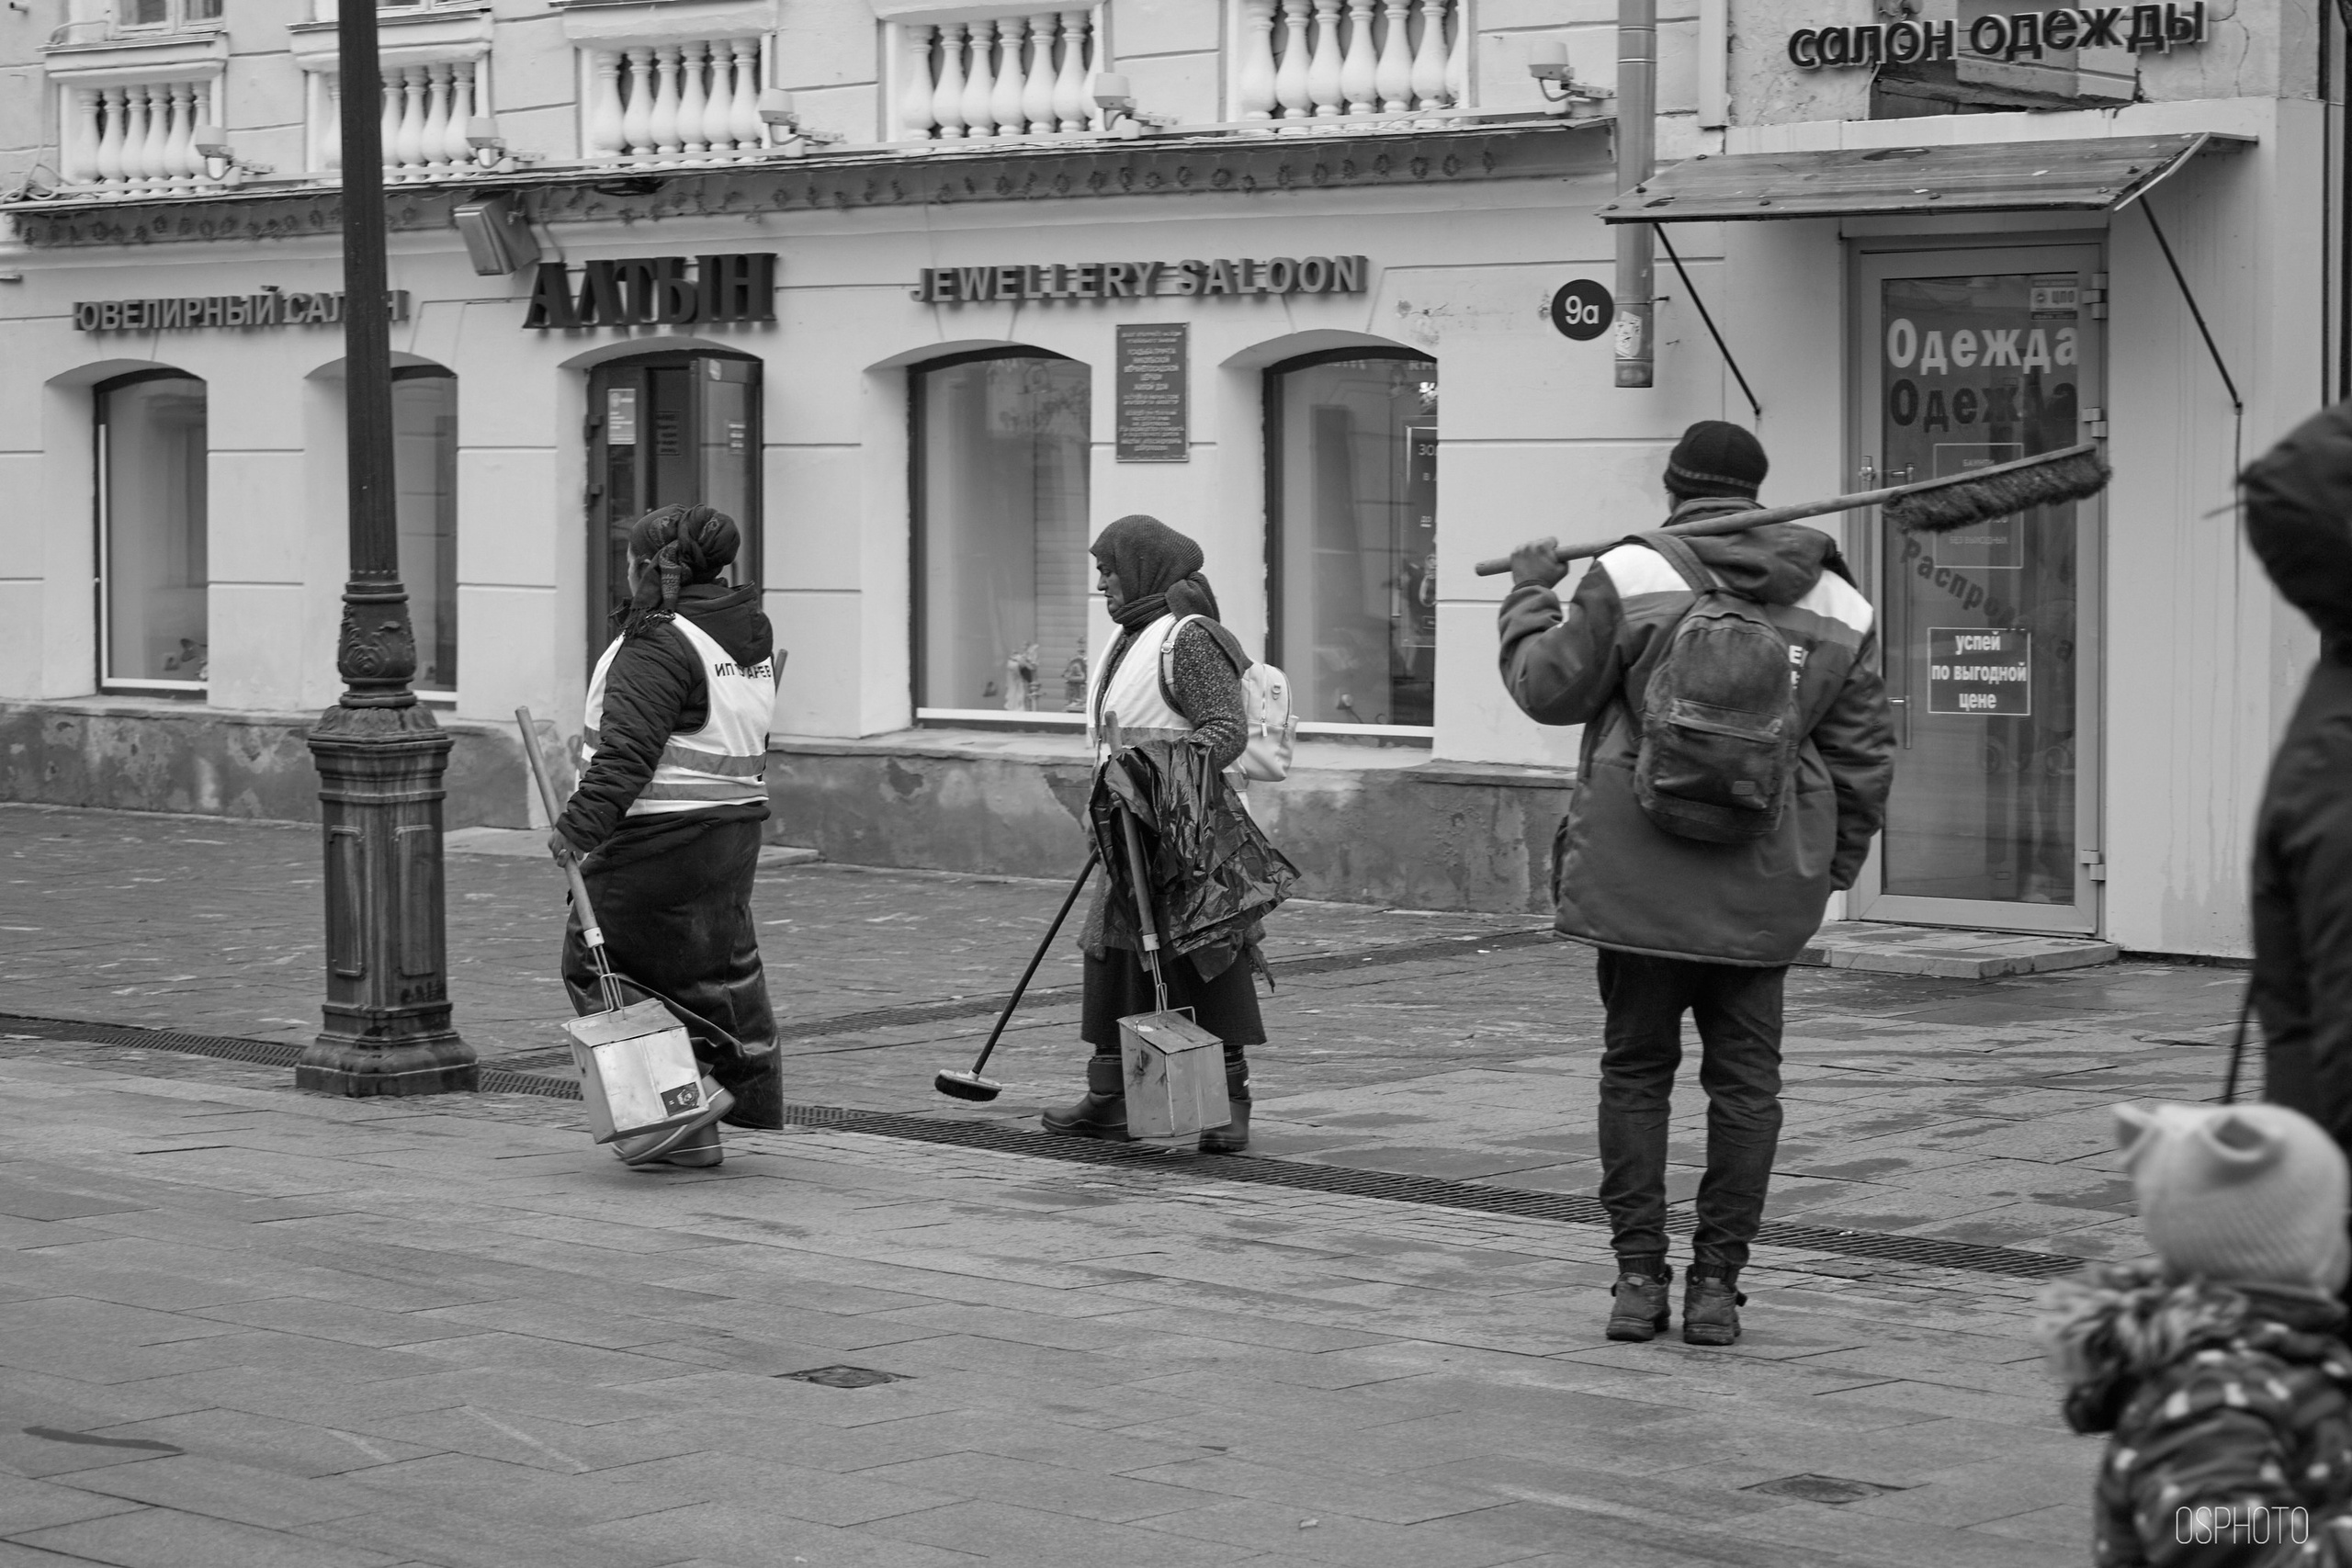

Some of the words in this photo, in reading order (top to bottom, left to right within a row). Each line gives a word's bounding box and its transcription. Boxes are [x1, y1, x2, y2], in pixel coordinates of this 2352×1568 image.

[1788, 19, 1958, 69] салон
[1970, 1, 2208, 64] одежды
[523, 253, 777, 329] АЛТЫН
[910, 262, 1164, 302] JEWELLERY
[1176, 255, 1367, 295] SALOON
[73, 286, 279, 331] ЮВЕЛИРНЫЙ
[281, 290, 410, 323] САЛН
[1565, 295, 1600, 324] 9а
[1887, 318, 2077, 375] Одежда
[1955, 630, 2001, 655] успей
[715, 662, 735, 677] ИП
[1931, 665, 1951, 680] по
[1953, 661, 2028, 684] выгодной
[1959, 693, 1997, 711] цене
